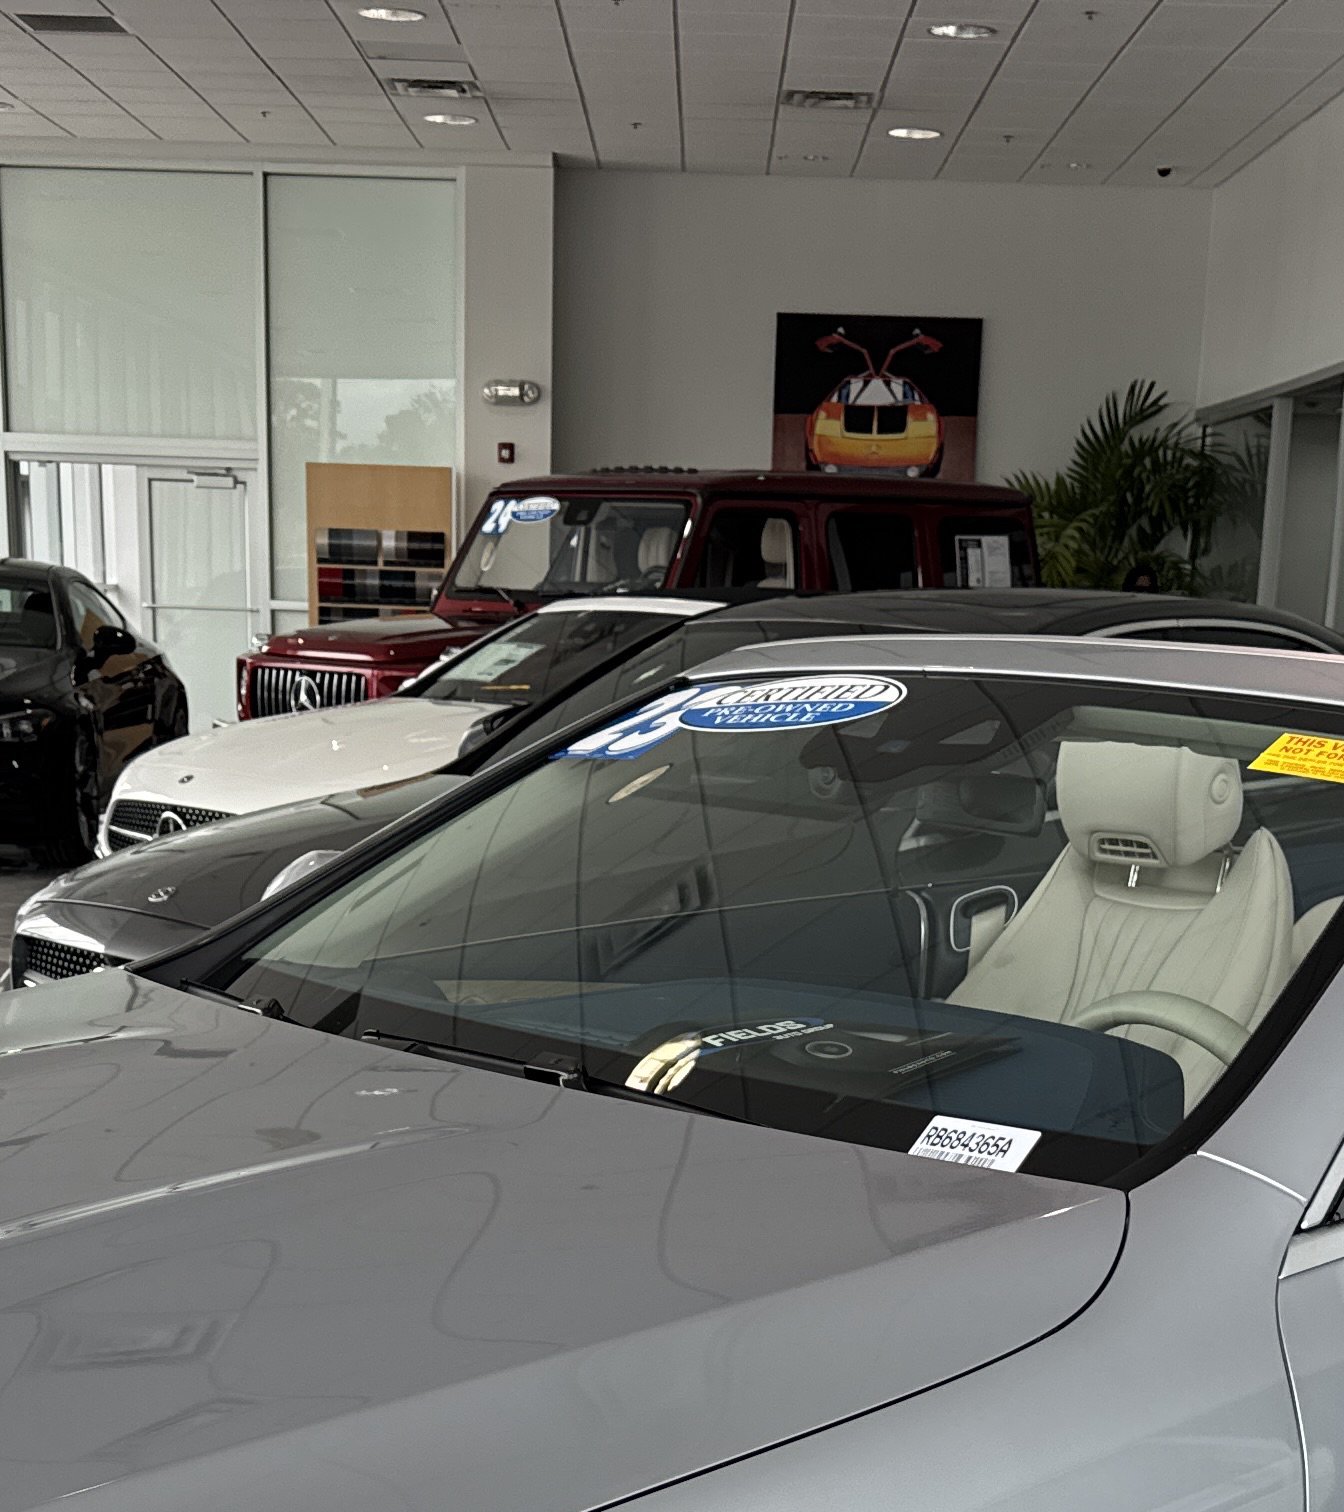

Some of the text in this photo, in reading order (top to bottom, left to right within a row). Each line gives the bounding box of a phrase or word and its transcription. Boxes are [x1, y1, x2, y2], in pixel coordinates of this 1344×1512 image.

[716, 684, 891, 705] CERTIFIED
[702, 702, 855, 717] PRE-OWNED
[714, 712, 820, 724] VEHICLE
[1285, 736, 1329, 749] THIS
[1279, 746, 1314, 755] NOT
[703, 1020, 807, 1047] FIELDS
[920, 1126, 1013, 1158] RB684365A
